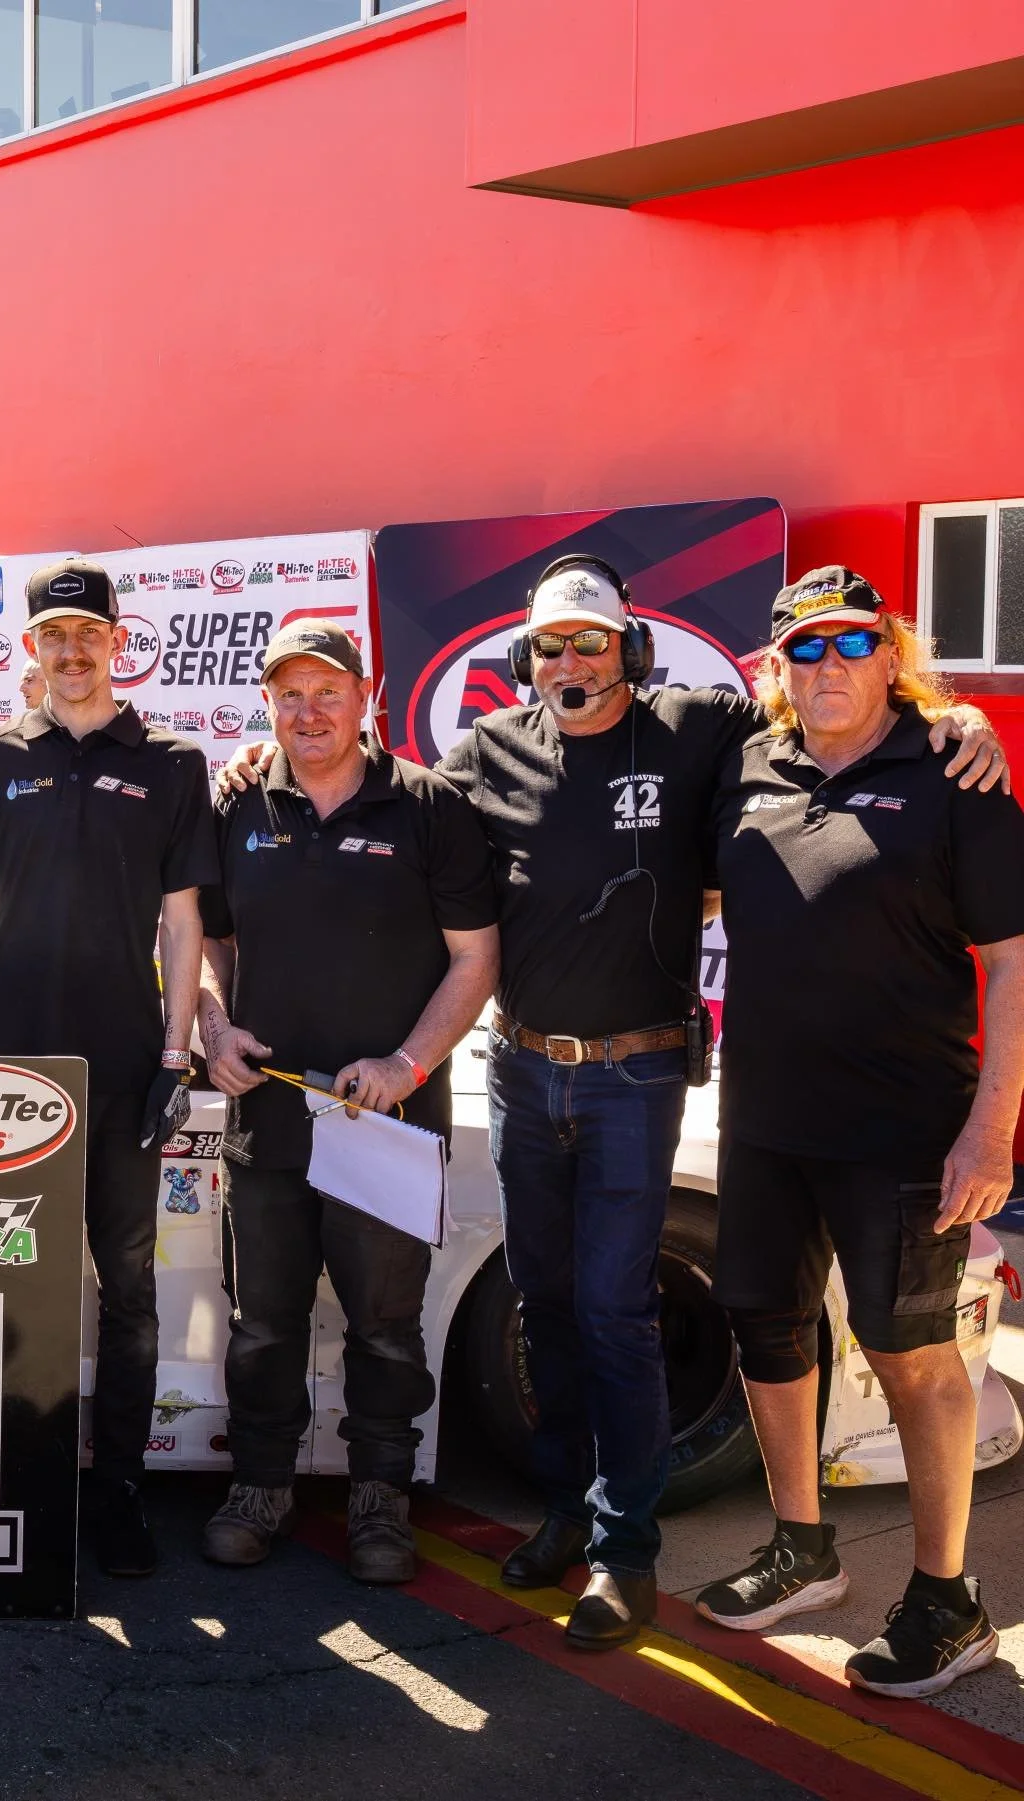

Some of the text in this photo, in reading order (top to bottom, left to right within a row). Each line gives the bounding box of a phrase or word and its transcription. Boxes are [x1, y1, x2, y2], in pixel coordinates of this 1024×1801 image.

[317, 557, 351, 568] HI-TEC
[172, 568, 201, 578] HI-TEC
[222, 565, 244, 576] Hi-Tec
[286, 563, 314, 574] Hi-Tec
[317, 567, 351, 575] RACING
[147, 572, 170, 583] Hi-Tec
[166, 611, 273, 649] SUPER
[123, 632, 157, 652] i-Tec
[114, 656, 137, 673] Oils
[149, 711, 171, 723] Hi-Tec
[173, 711, 201, 720] HI-TEC
[222, 711, 242, 722] Hi-Tec
[95, 776, 121, 791] 29
[608, 774, 664, 788] TOM DAVIES
[613, 782, 660, 819] 42
[614, 818, 661, 829] RACING
[339, 837, 366, 852] 29
[163, 1144, 178, 1152] Oils
[855, 1430, 875, 1441] DAVIES
[876, 1426, 896, 1436] RACING
